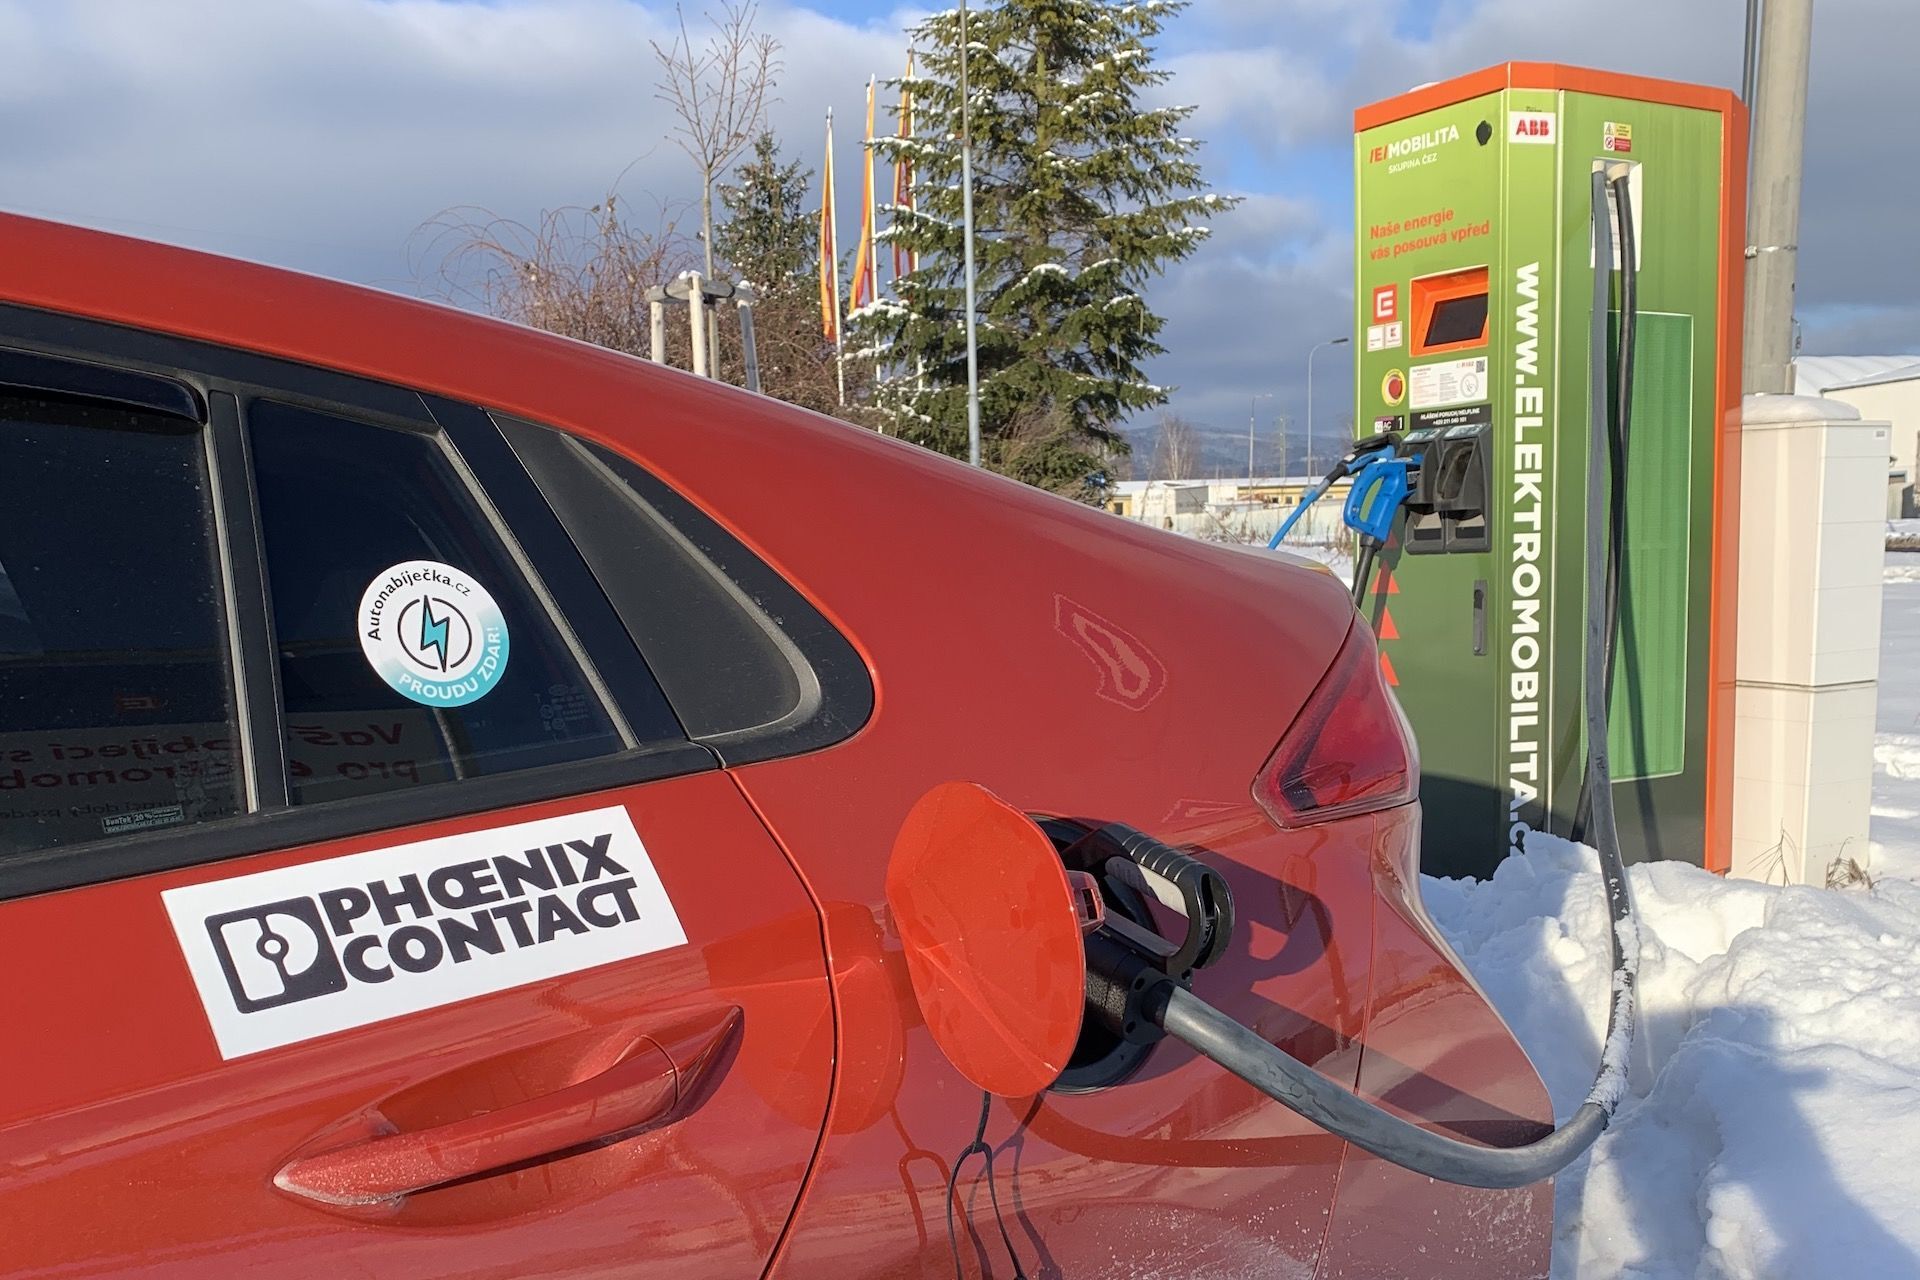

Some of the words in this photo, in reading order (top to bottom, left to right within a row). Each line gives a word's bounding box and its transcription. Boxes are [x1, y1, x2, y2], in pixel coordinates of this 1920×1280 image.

[1515, 119, 1550, 136] ABB
[1388, 158, 1421, 174] SKUPINA
[1421, 152, 1438, 165] ČEZ
[1370, 222, 1401, 239] Naše
[1404, 208, 1454, 227] energie
[1370, 244, 1390, 261] vás
[1393, 229, 1447, 258] posouvá
[1450, 219, 1490, 242] vpřed
[367, 567, 472, 642] Autonabíječka.cz
[398, 672, 480, 700] PROUDU
[477, 626, 502, 682] ZDAR!
[343, 876, 642, 985] CONTACT
